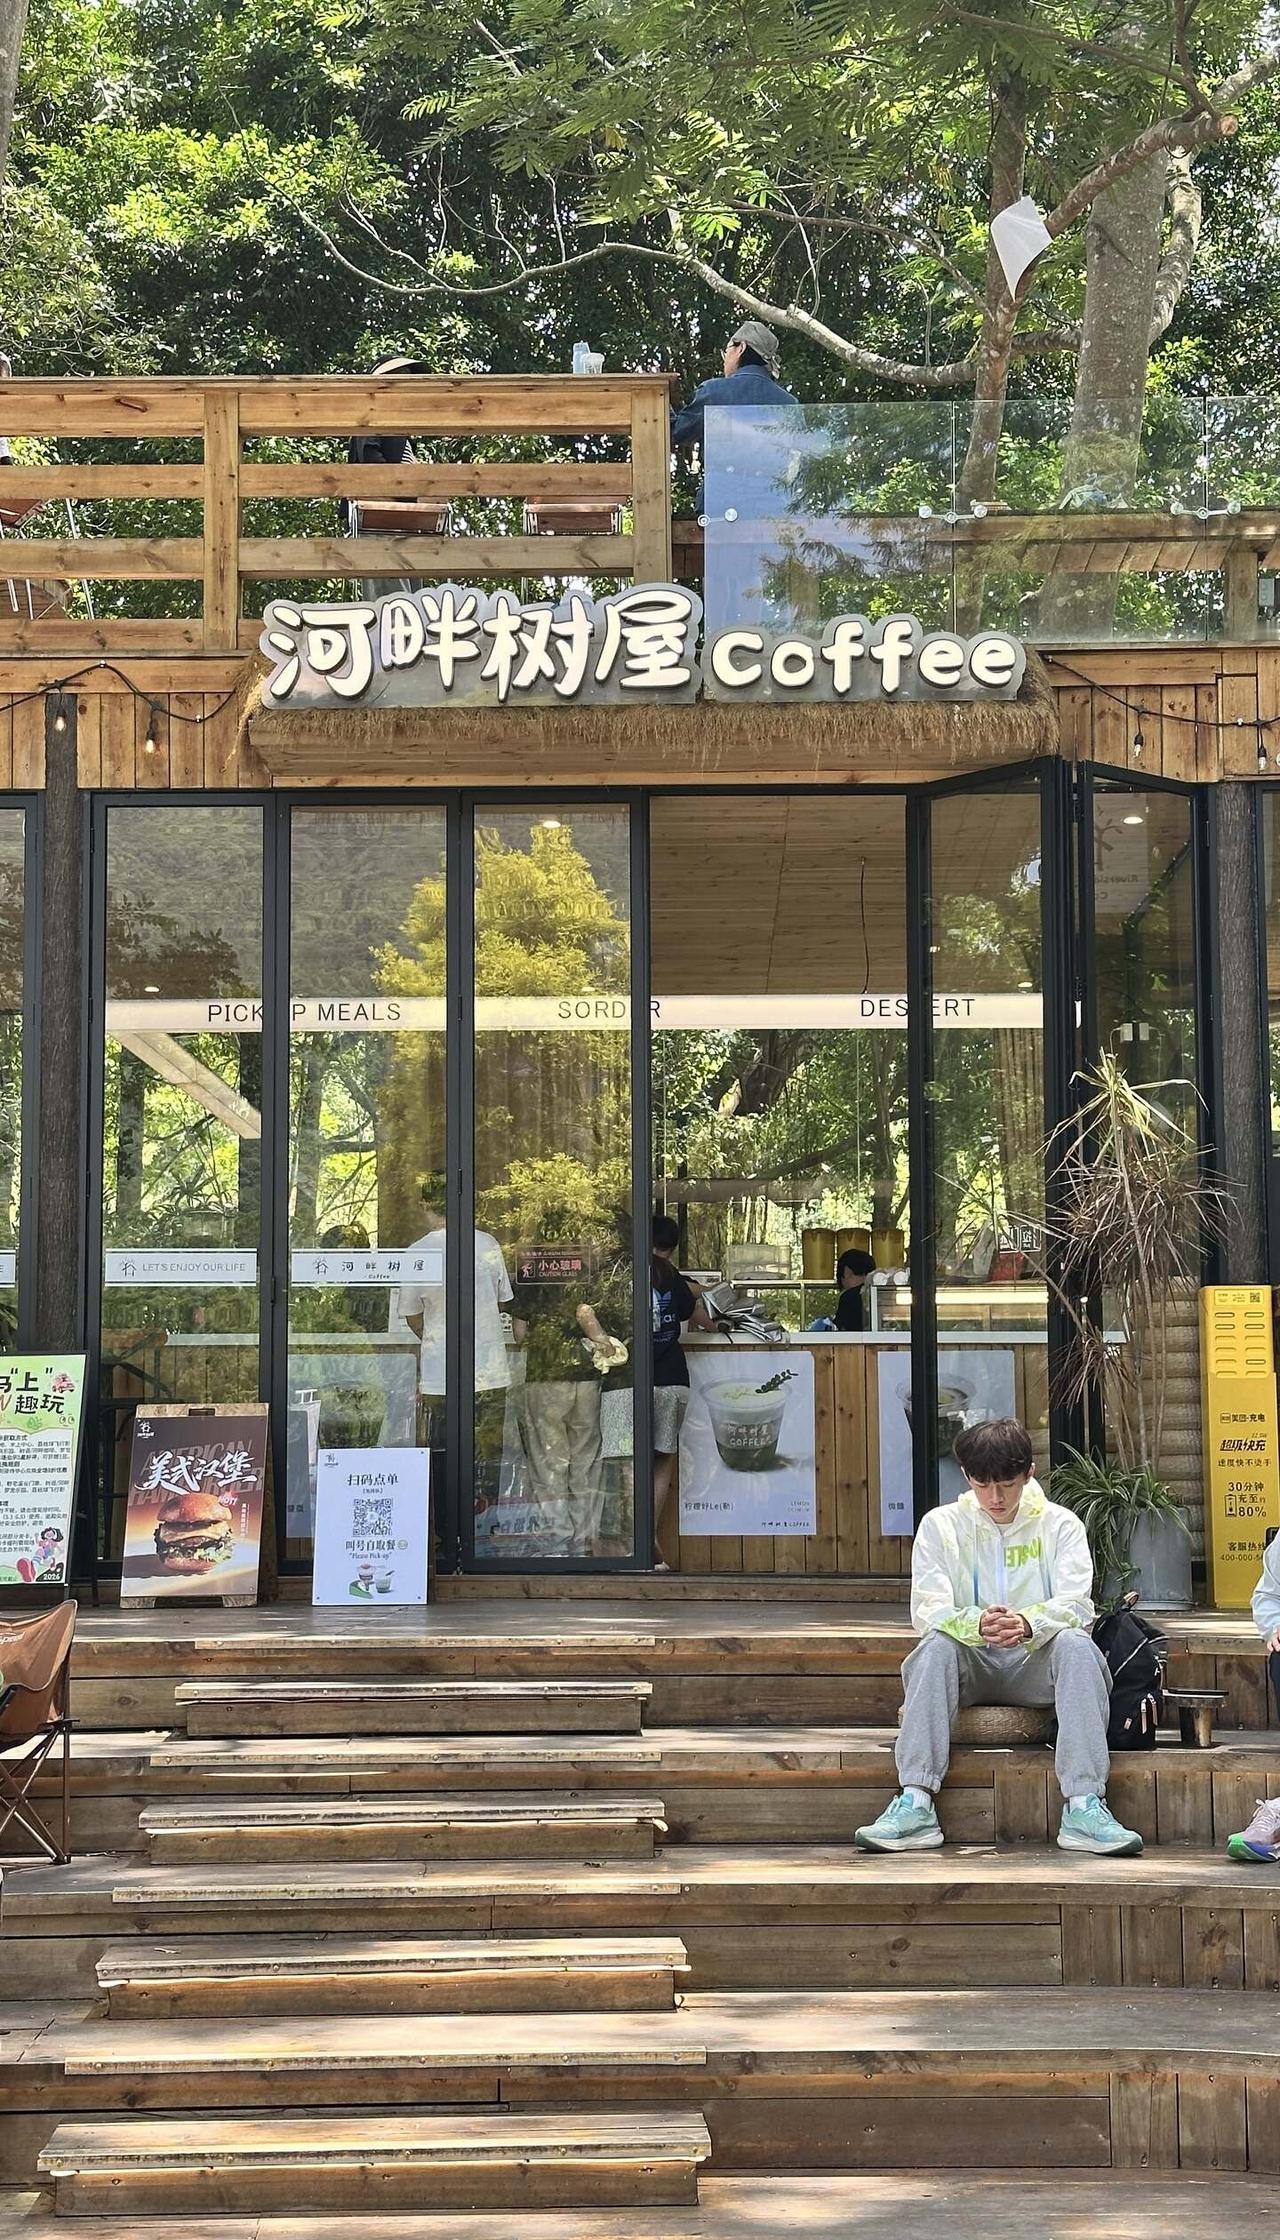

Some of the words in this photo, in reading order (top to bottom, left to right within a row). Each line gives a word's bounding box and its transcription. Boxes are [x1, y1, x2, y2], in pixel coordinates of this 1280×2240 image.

[271, 590, 694, 700] 河畔树屋
[711, 614, 1017, 697] coffee
[207, 1004, 263, 1022] PICK
[317, 1003, 401, 1021] MEALS
[558, 1000, 661, 1020] SORDR
[860, 998, 975, 1017] DESERT
[170, 1263, 201, 1272] ENJOY
[203, 1263, 223, 1272] OUR
[225, 1263, 246, 1272] LIFE
[538, 1259, 582, 1271] 小心玻璃
[15, 1393, 65, 1414] 趣玩
[1219, 1439, 1267, 1451] 超级快充
[134, 1450, 258, 1496] 美式汉堡
[347, 1473, 399, 1486] 扫码点单
[1228, 1482, 1264, 1492] 30分钟
[1238, 1506, 1267, 1517] 80%
[345, 1540, 396, 1551] 叫号自取餐
